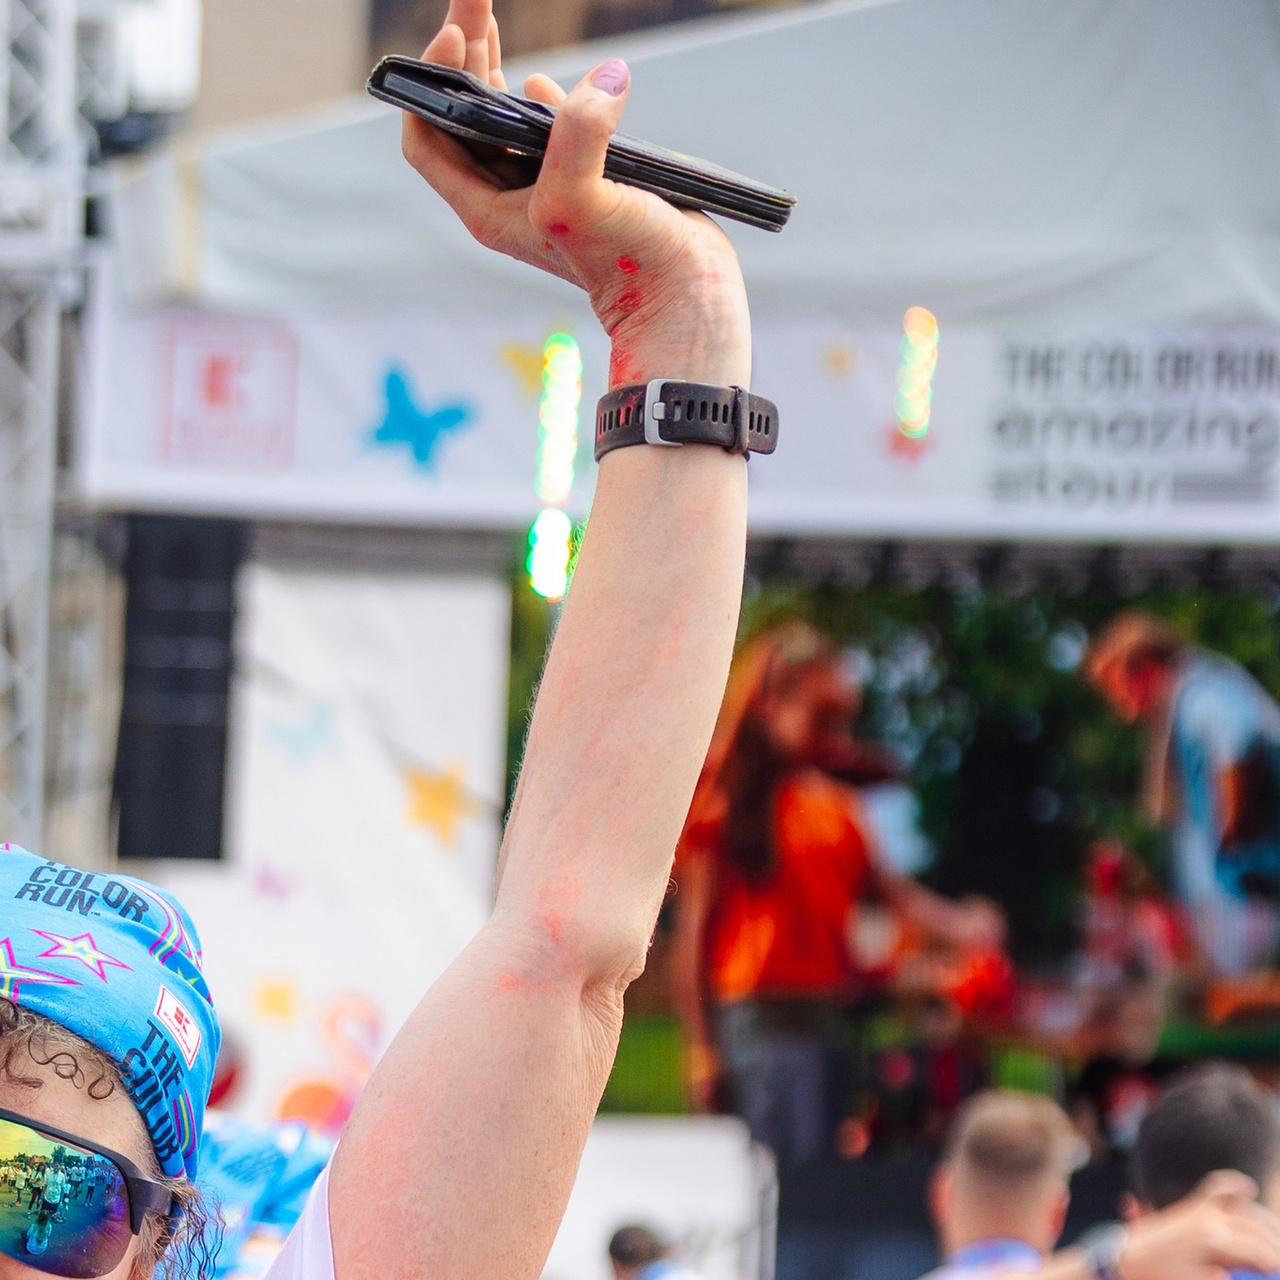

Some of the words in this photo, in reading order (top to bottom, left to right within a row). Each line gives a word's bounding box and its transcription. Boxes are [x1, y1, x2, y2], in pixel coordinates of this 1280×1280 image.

[992, 402, 1280, 480] amazing
[29, 865, 150, 923] COLOR
[141, 1019, 184, 1100] THE
